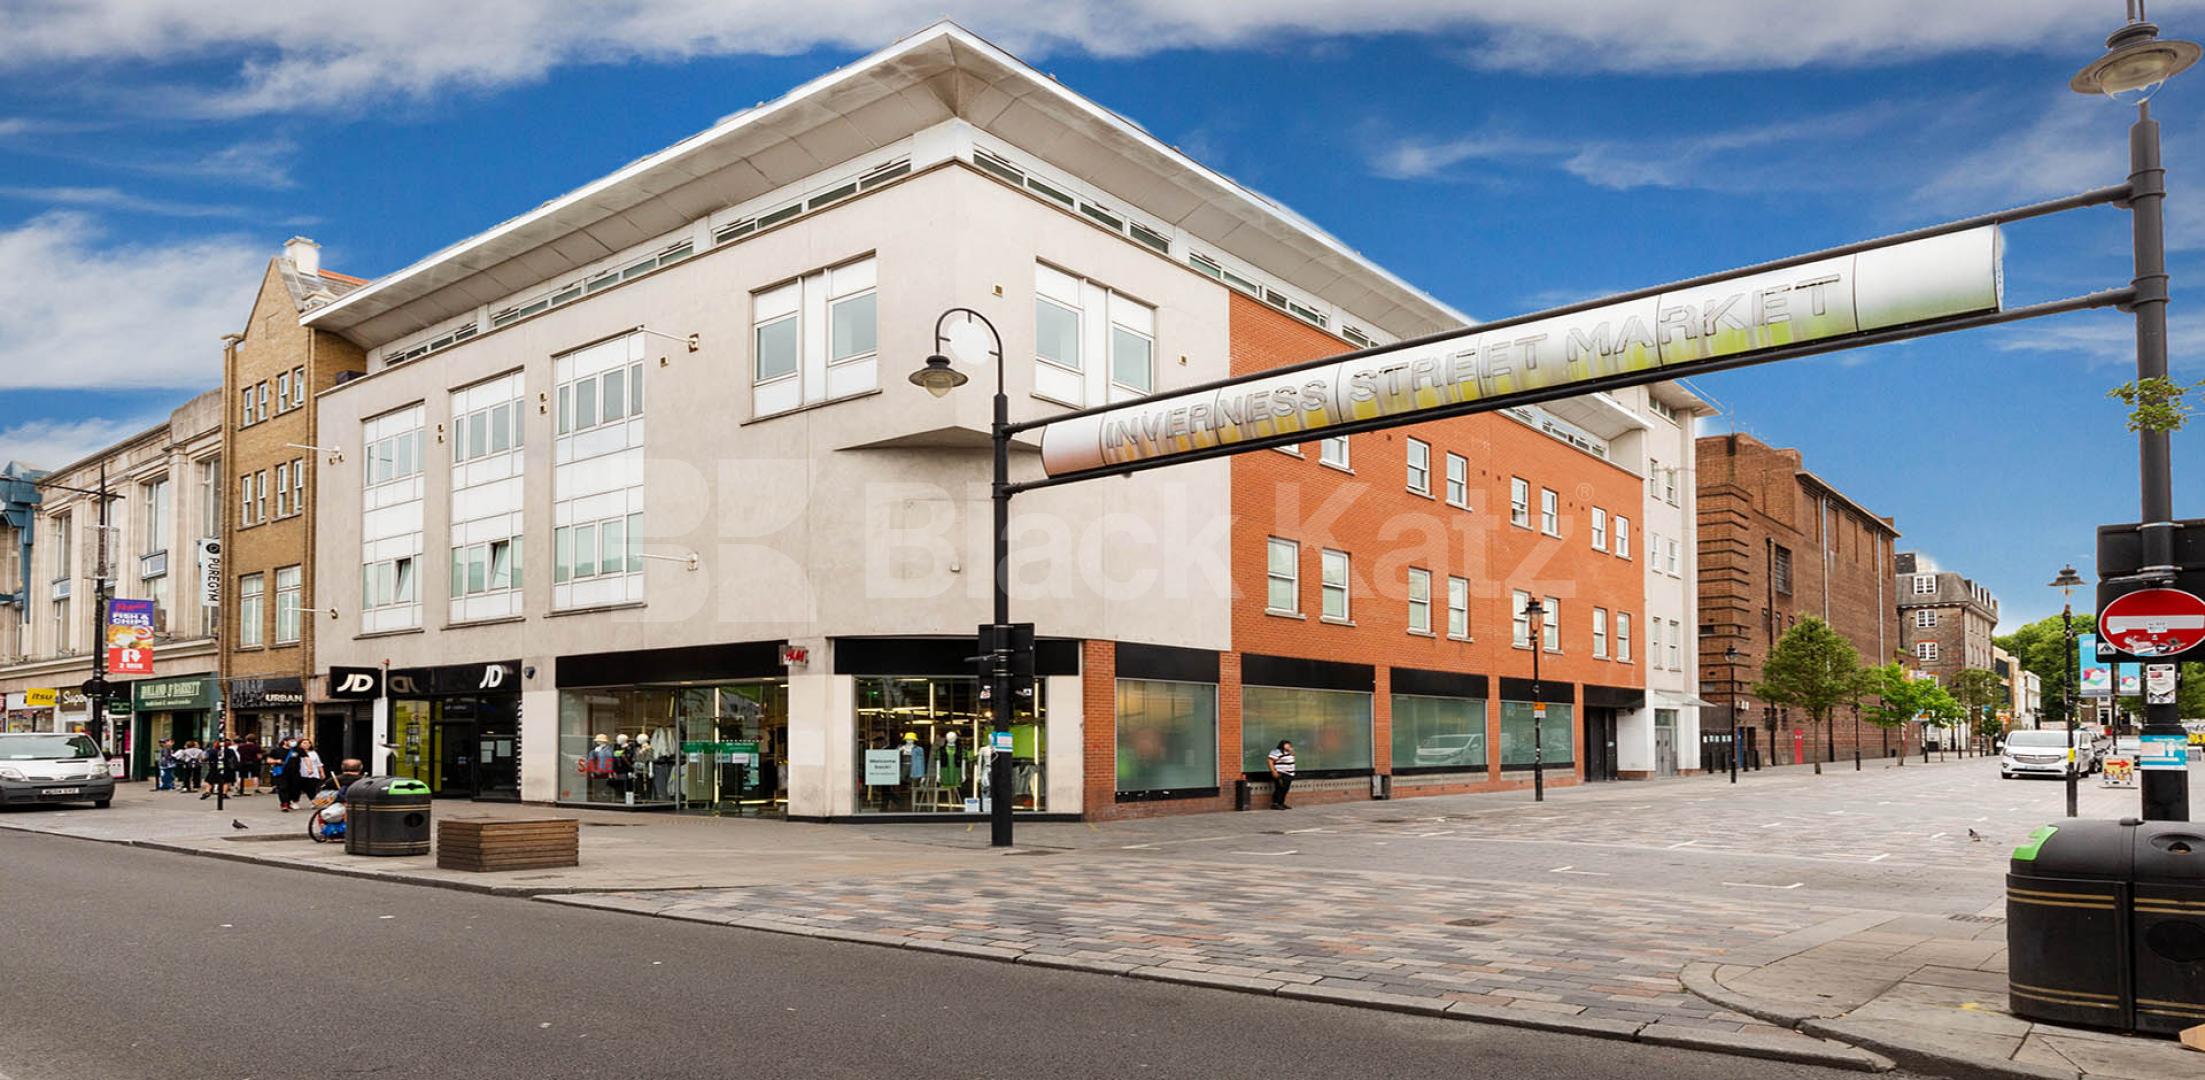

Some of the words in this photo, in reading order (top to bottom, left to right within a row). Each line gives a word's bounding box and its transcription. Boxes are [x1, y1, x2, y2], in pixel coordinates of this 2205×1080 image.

[1106, 380, 1328, 449] INVERNESS
[1350, 333, 1548, 402] STREET
[1566, 273, 1841, 363] MARKET
[207, 557, 220, 602] PUREGYM
[113, 618, 149, 626] CHIPS
[336, 674, 374, 692] JD
[479, 664, 503, 689] JD
[265, 693, 303, 702] URBAN
[577, 757, 616, 773] SALE
